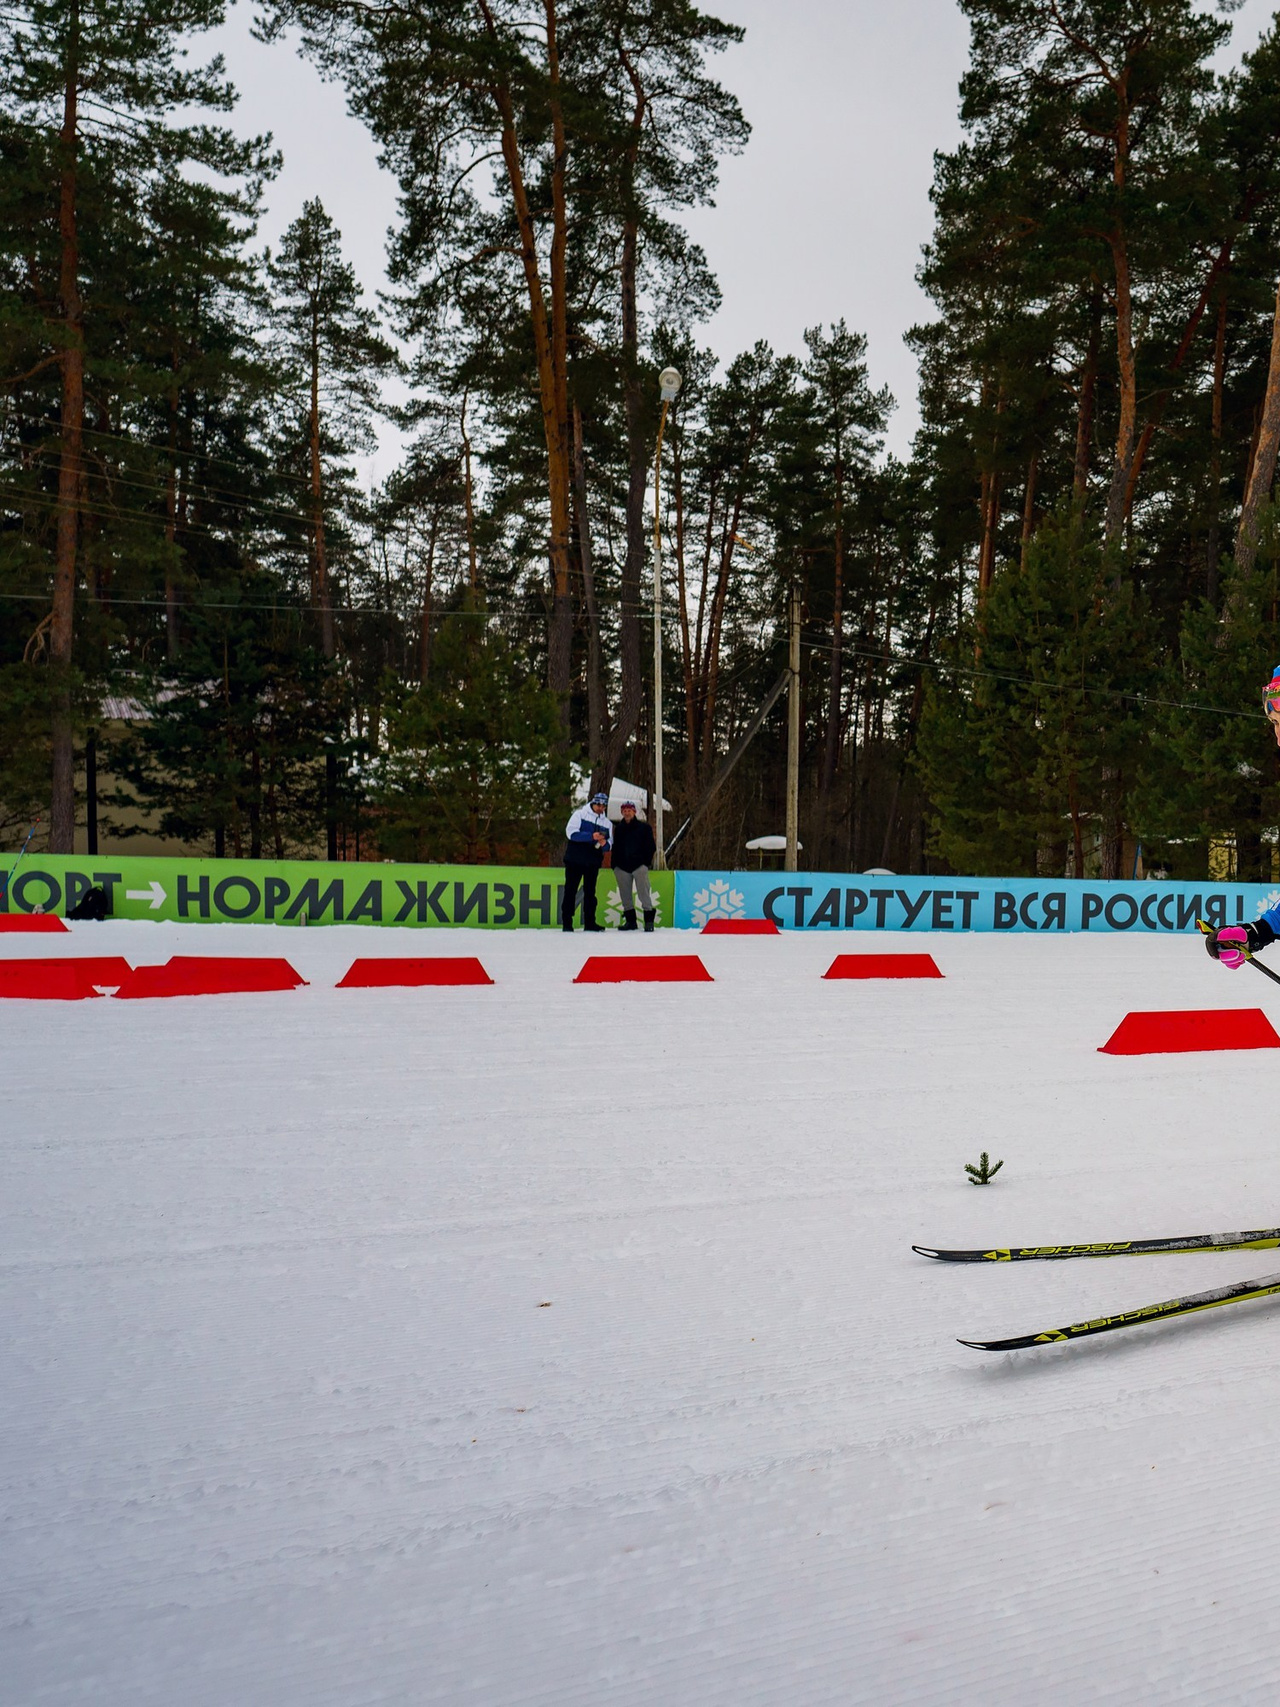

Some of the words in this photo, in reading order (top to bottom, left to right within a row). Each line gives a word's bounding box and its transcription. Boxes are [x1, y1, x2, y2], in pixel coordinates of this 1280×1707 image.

[0, 870, 122, 915] ОРТ
[177, 874, 383, 922] НОРМА
[762, 886, 980, 930] СТАРТУЕТ
[993, 891, 1067, 930] ВСЯ
[1019, 1242, 1132, 1256] FISCHER
